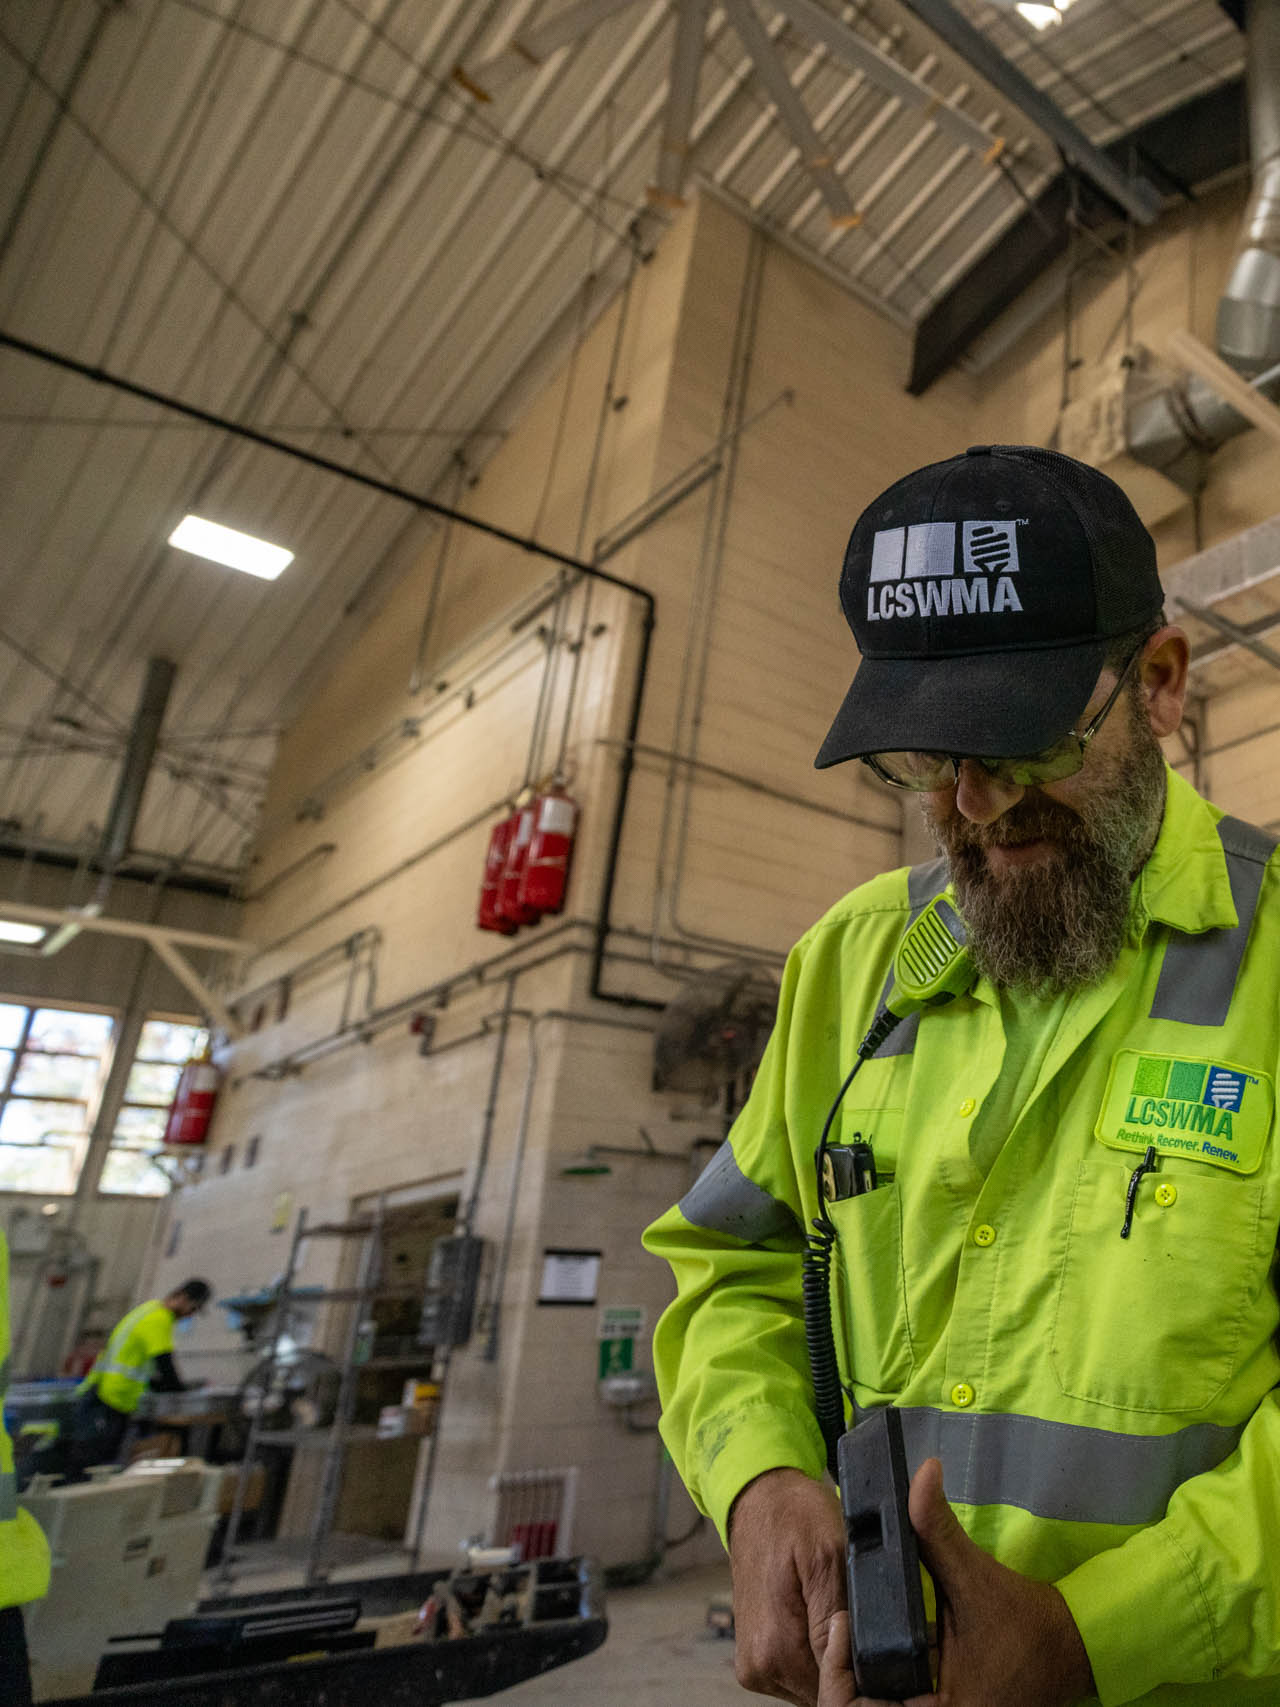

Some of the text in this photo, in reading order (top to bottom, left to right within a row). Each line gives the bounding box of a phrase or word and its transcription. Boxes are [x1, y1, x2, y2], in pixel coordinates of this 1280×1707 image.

[867, 576, 1024, 622] LCSWMA
[1124, 1096, 1233, 1141] LCSWMA
[1157, 1133, 1200, 1152] Recover.
[1202, 1141, 1240, 1163] Renew.
